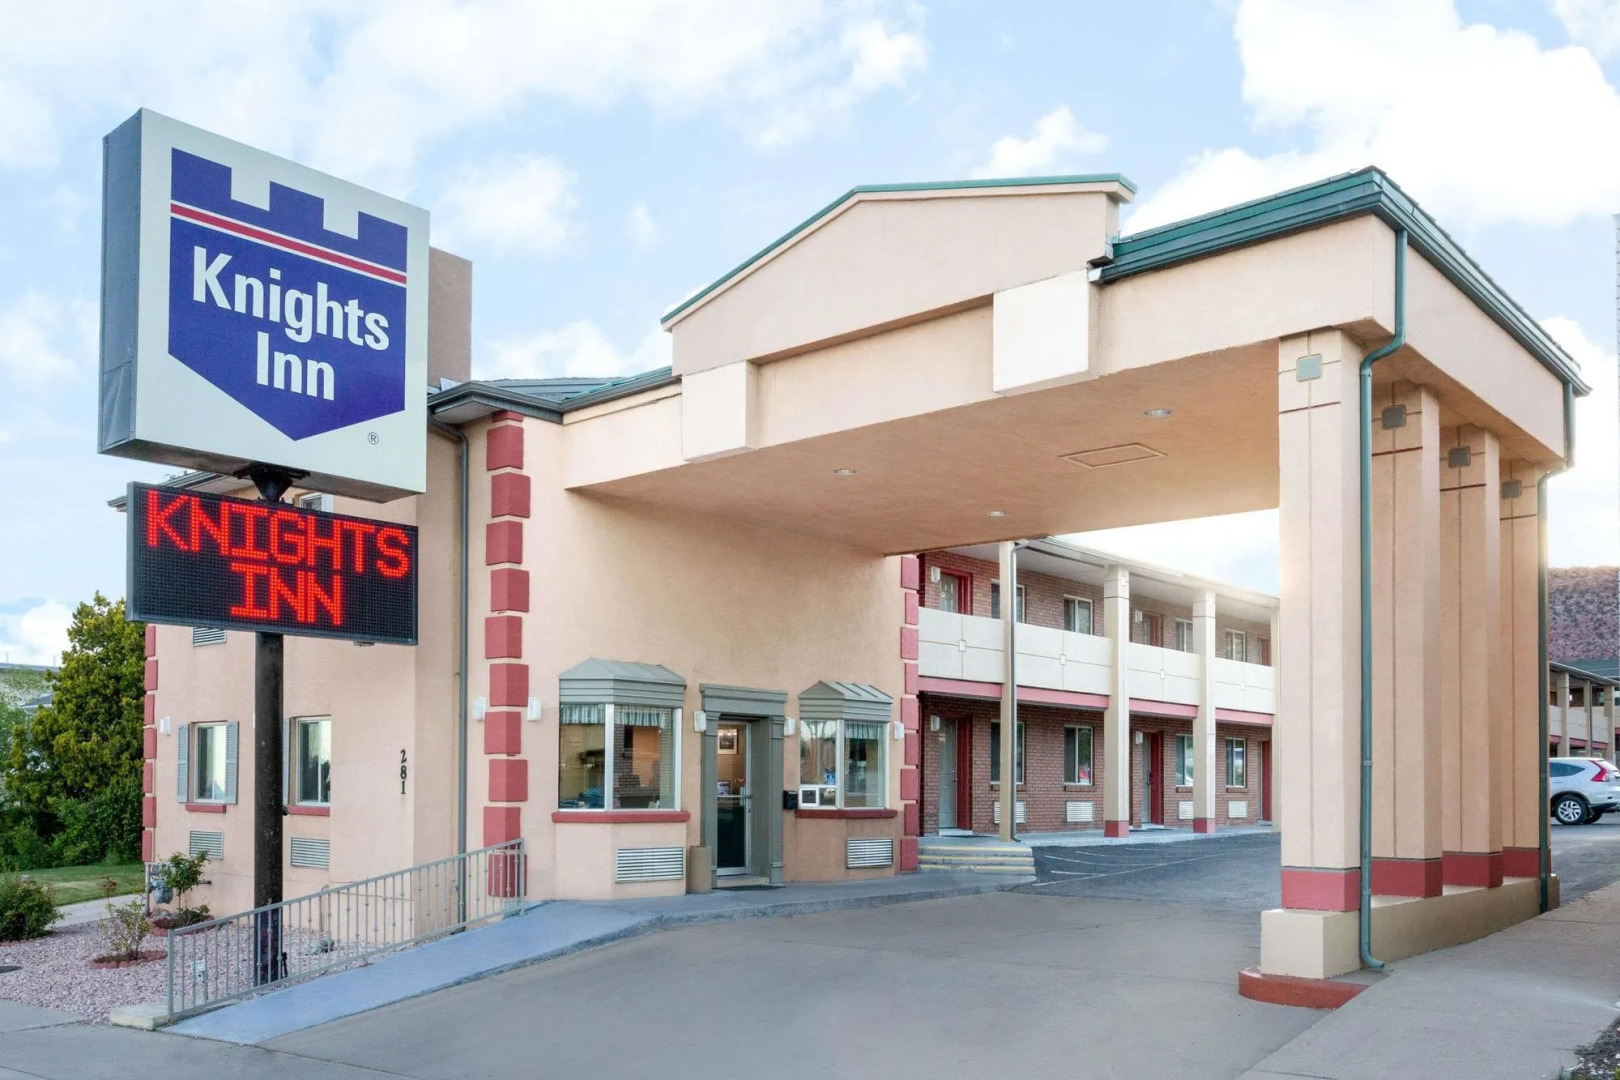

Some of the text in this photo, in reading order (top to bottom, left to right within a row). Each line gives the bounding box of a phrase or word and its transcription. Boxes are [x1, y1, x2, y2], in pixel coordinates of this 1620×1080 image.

[193, 245, 389, 351] Knights
[255, 332, 336, 401] Inn
[146, 489, 410, 578] KNIGHTS
[230, 561, 343, 626] INN
[399, 748, 408, 795] 281
